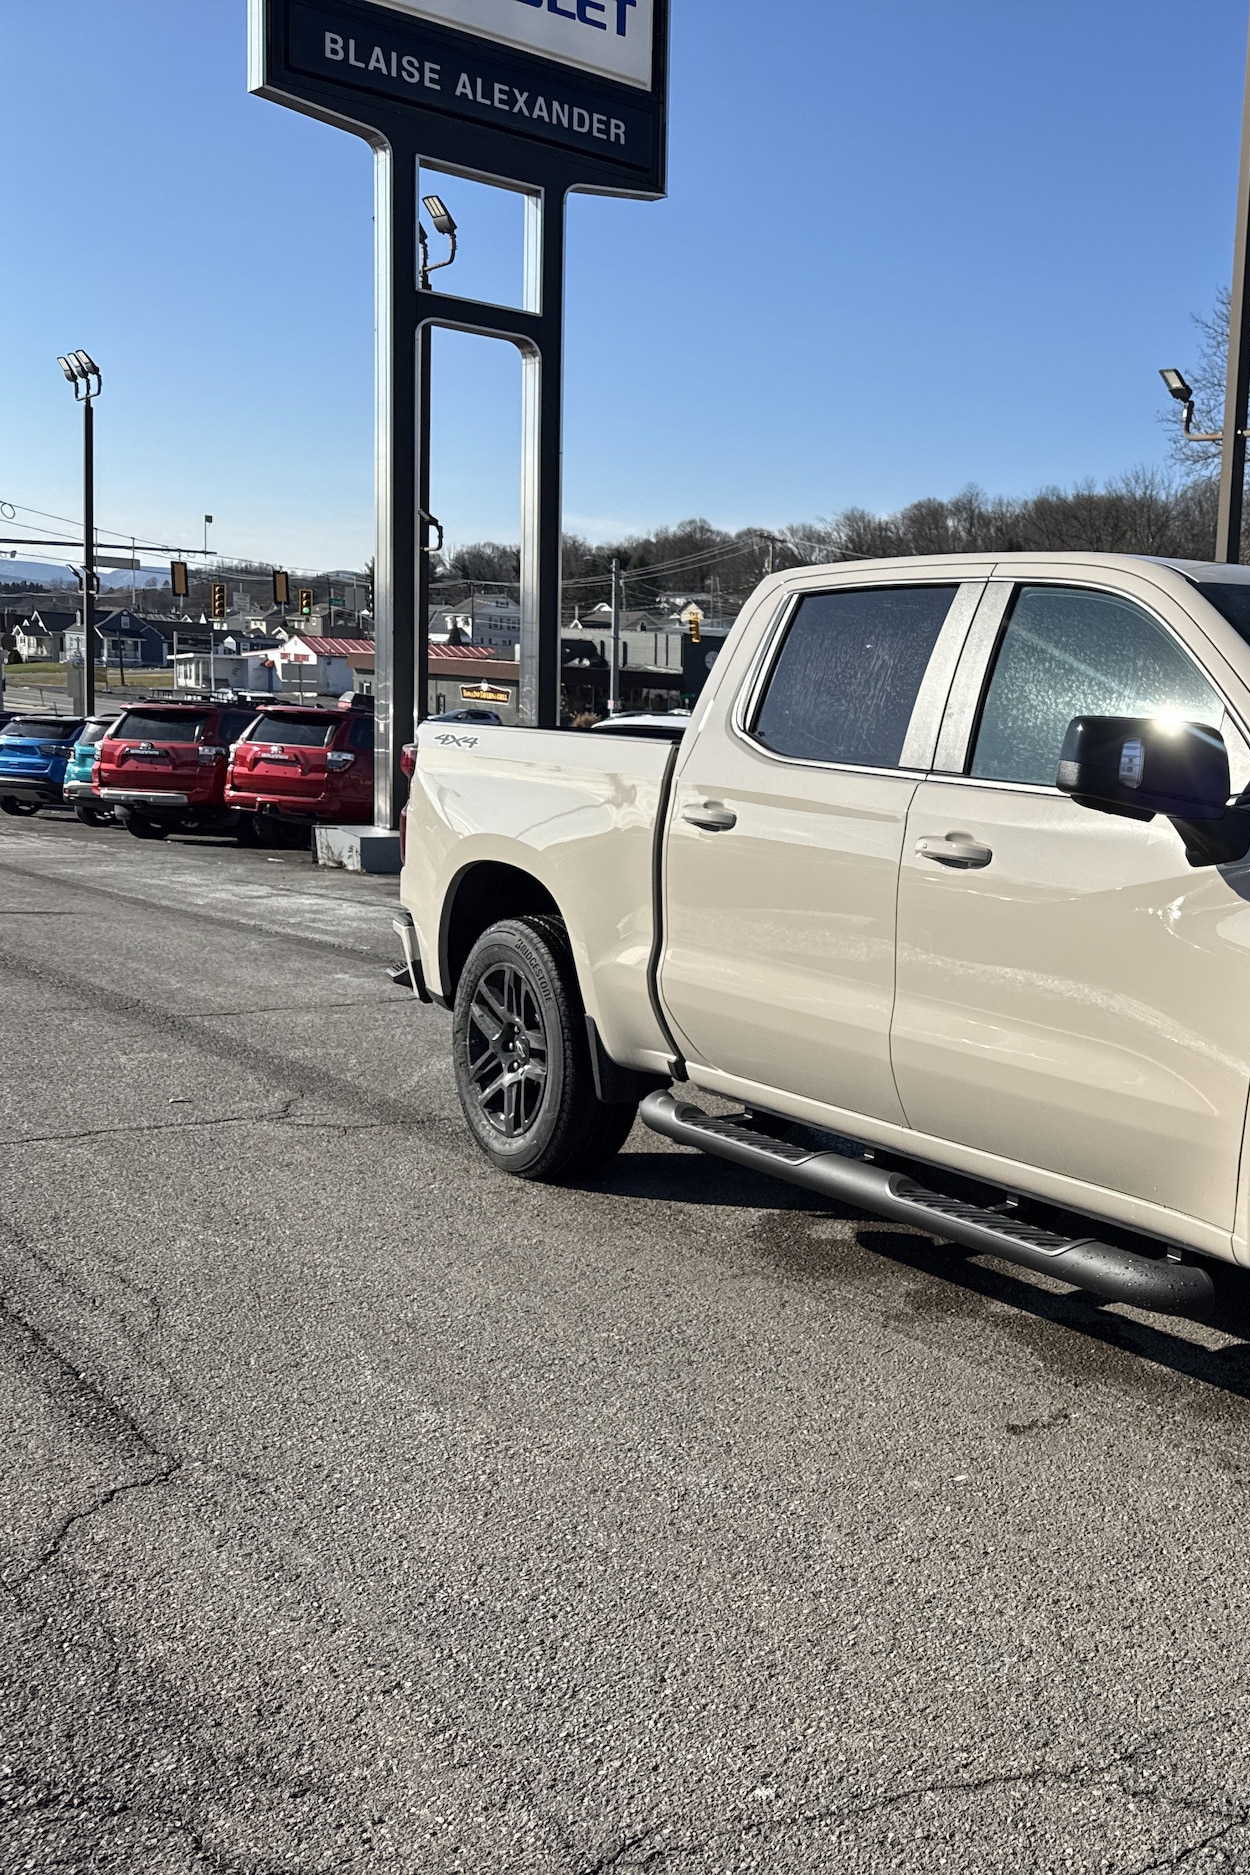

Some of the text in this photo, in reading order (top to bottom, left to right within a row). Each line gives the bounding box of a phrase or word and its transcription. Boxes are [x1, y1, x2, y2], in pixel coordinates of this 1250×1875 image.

[516, 0, 637, 37] LET
[324, 31, 626, 145] BLAISE ALEXANDER
[514, 938, 554, 1004] BRIDGESTONE
